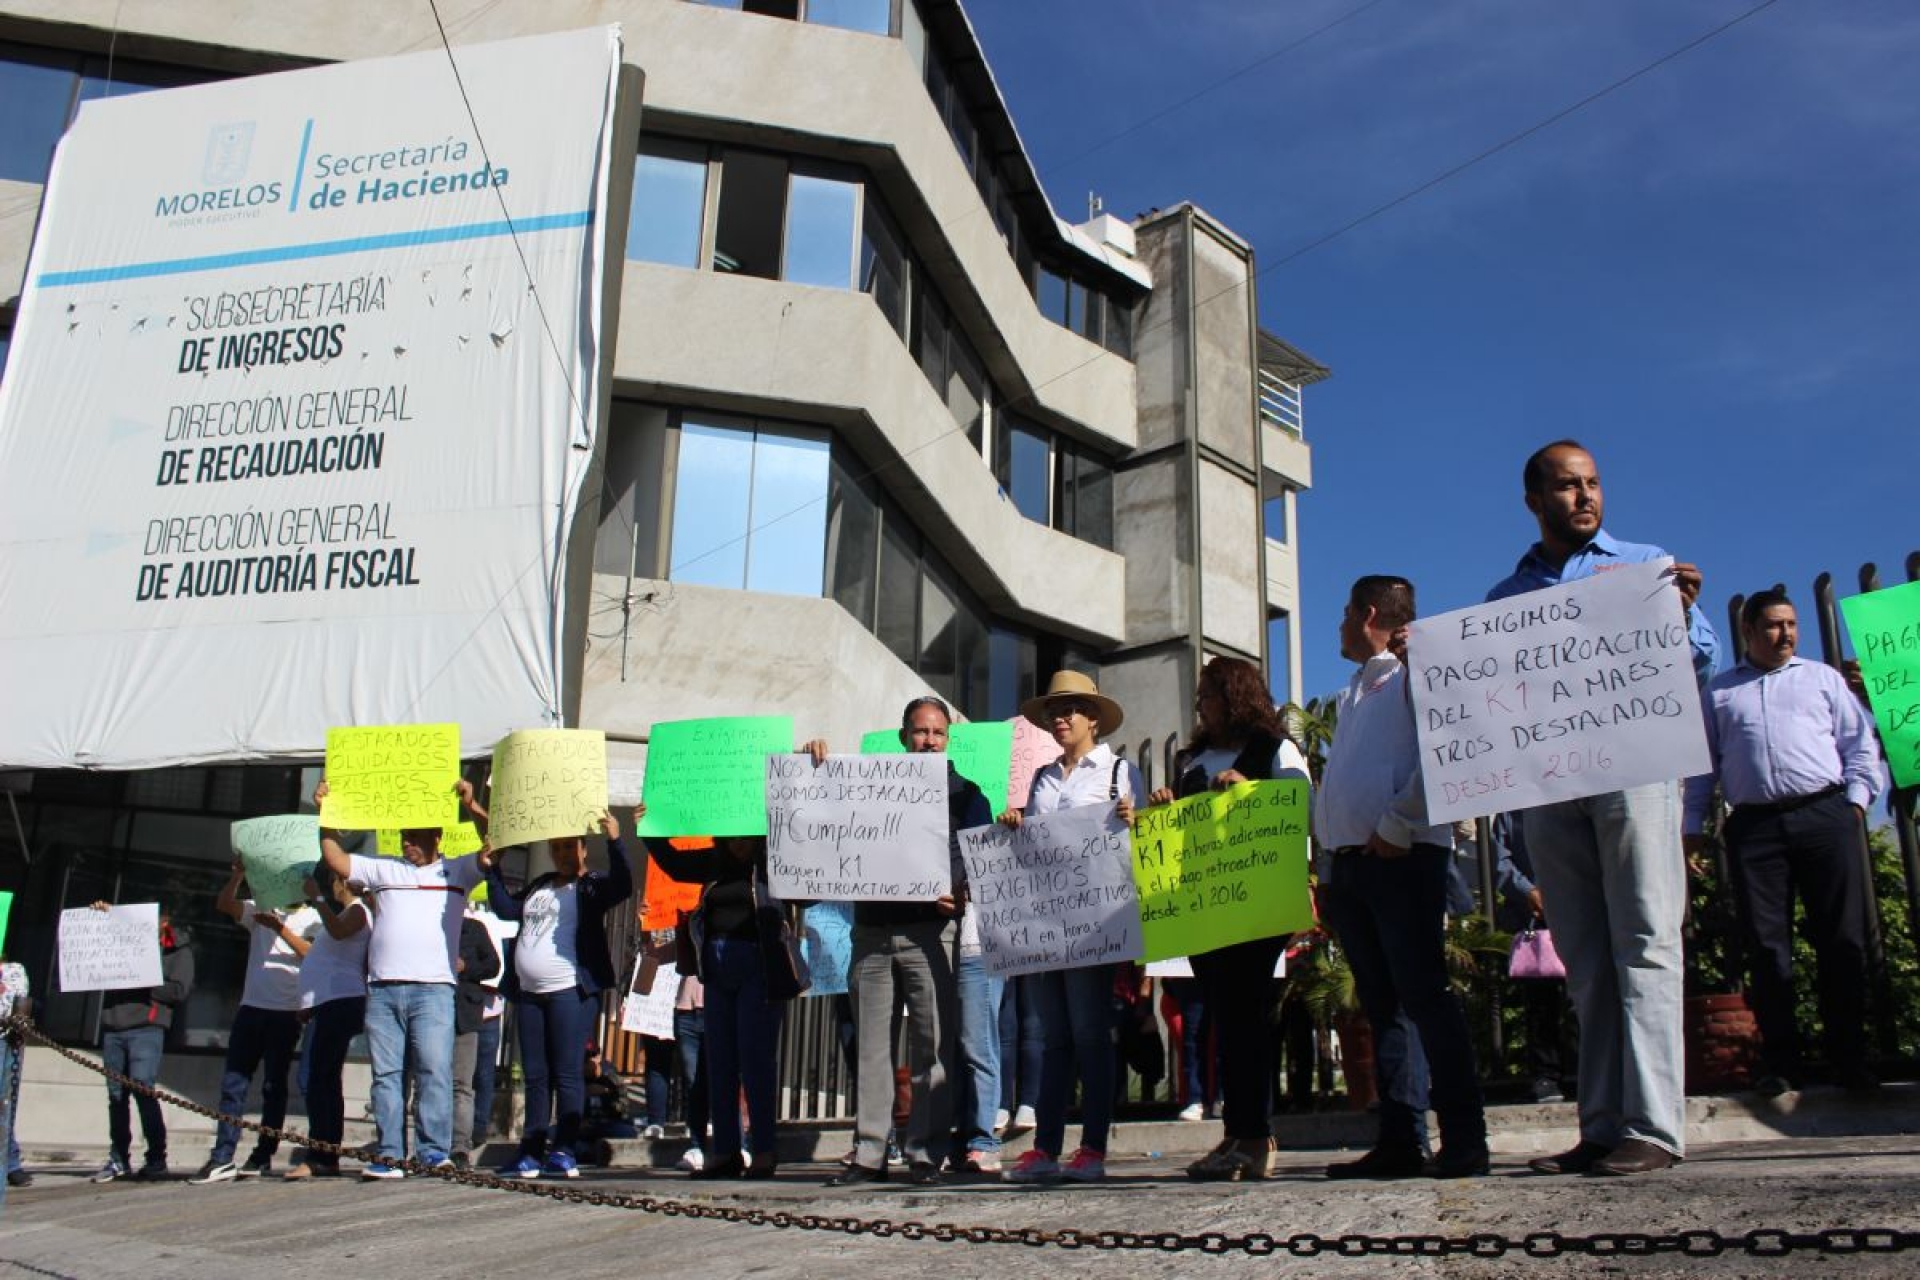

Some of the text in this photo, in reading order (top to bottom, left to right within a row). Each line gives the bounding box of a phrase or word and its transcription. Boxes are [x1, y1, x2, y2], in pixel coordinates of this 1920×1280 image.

[314, 136, 468, 179] Secretaría
[155, 182, 281, 217] MORELOS
[309, 159, 509, 210] de Hacienda
[187, 271, 386, 331] SUBSECRETARÍA
[178, 323, 346, 373] DE INGRESOS
[165, 384, 413, 441] DIRECCIÓN GENERAL
[157, 426, 385, 486] DE RECAUDACIÓN
[144, 502, 397, 556] DIRECCIÓN GENERAL
[136, 546, 421, 601] DE AUDITORÍA FISCAL
[1459, 598, 1582, 640] EXIGIMOS
[1424, 622, 1685, 692] PAGO RETROACTIVO
[1872, 668, 1917, 695] DEL
[1428, 703, 1473, 732] DEL
[1552, 679, 1572, 703] A
[331, 731, 452, 751] DESTACADOS
[1433, 690, 1683, 767] TROS DESTACADOS
[329, 772, 430, 791] EXIGIMOS
[330, 751, 449, 770] OLVIDADOS
[769, 756, 804, 780] NOS
[1442, 749, 1612, 805] DESDE 2016
[532, 795, 558, 810] DE
[770, 783, 943, 804] SOMOS DESTACADOS
[1134, 788, 1297, 839] EXIGIMOS pago del
[971, 832, 1121, 880] DESTACADOS 2015
[1138, 818, 1302, 870] K1 en horas adicionales
[770, 854, 863, 885] Paguen K1
[805, 879, 942, 897] RETROACTIVO 2016
[980, 864, 1089, 904] EXIGIMOS
[1150, 875, 1161, 893] el
[1169, 871, 1202, 894] pago
[1206, 850, 1279, 878] retroactivo
[982, 883, 1131, 930] PAGO RETROACTIVO
[1141, 881, 1249, 923] desde el 2016
[1010, 927, 1029, 946] K1
[1039, 930, 1055, 942] en
[1063, 919, 1102, 938] horas
[993, 951, 1059, 972] adicionales
